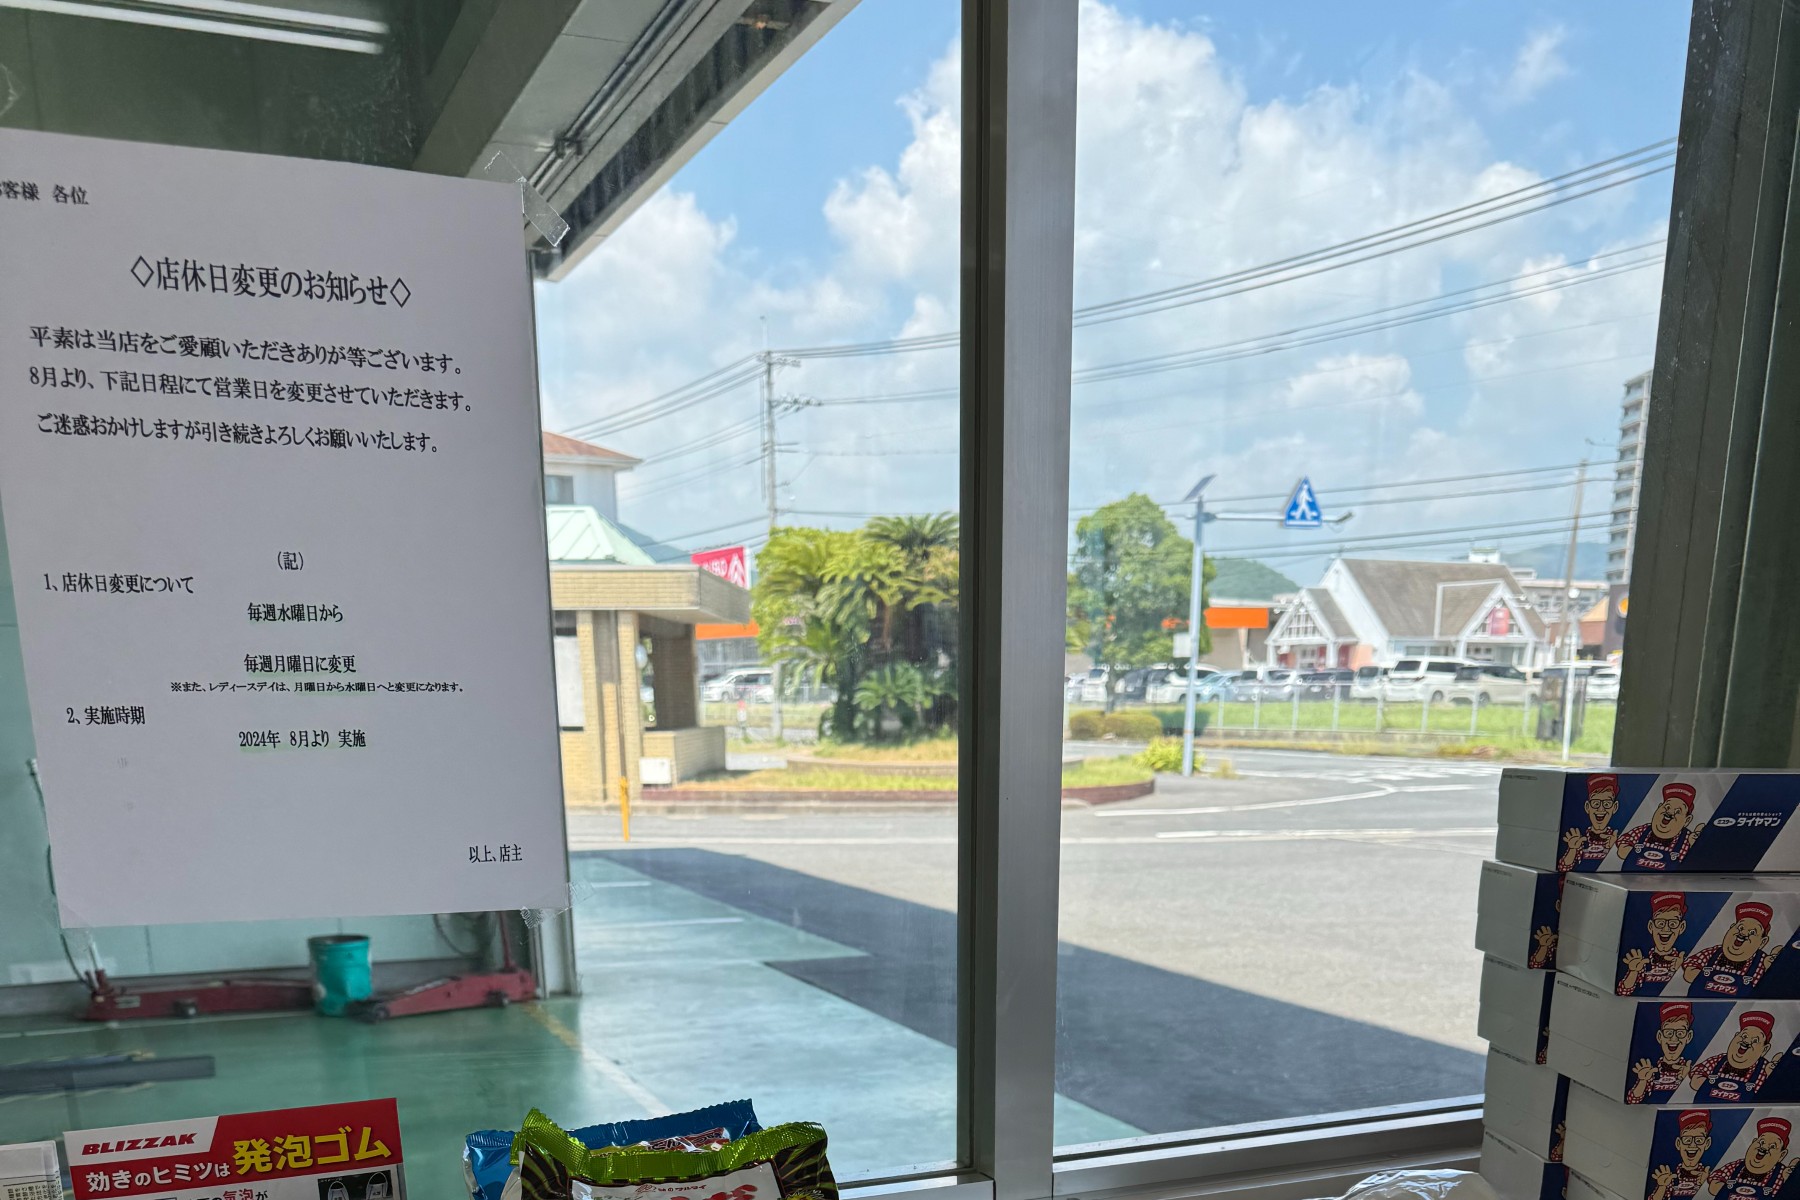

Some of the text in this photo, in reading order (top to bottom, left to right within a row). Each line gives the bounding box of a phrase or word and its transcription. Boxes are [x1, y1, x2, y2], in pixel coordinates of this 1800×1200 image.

[52, 183, 89, 205] 各位
[29, 326, 463, 376] 平素は当店をご愛顧いただきありが等ございます。
[29, 366, 471, 413] 8月より、下記日程にて営業日を変更させていただきます。
[37, 413, 438, 454] ご迷惑おかけしますが引き続きよろしくお願いいたします。
[246, 602, 344, 624] 毎週水曜日から
[243, 654, 357, 675] 毎週月曜日に変更
[66, 706, 146, 726] 2、実施時期
[238, 729, 367, 750] 2024年 8月より 実施
[1736, 816, 1782, 827] タイヤマン
[468, 843, 524, 864] 以上、店主
[1705, 981, 1738, 995] タイヤマン
[1710, 1089, 1741, 1101] タイヤマン
[81, 1132, 198, 1156] BLIZZAK
[86, 1125, 392, 1194] 効きのヒミツは 発泡ゴム
